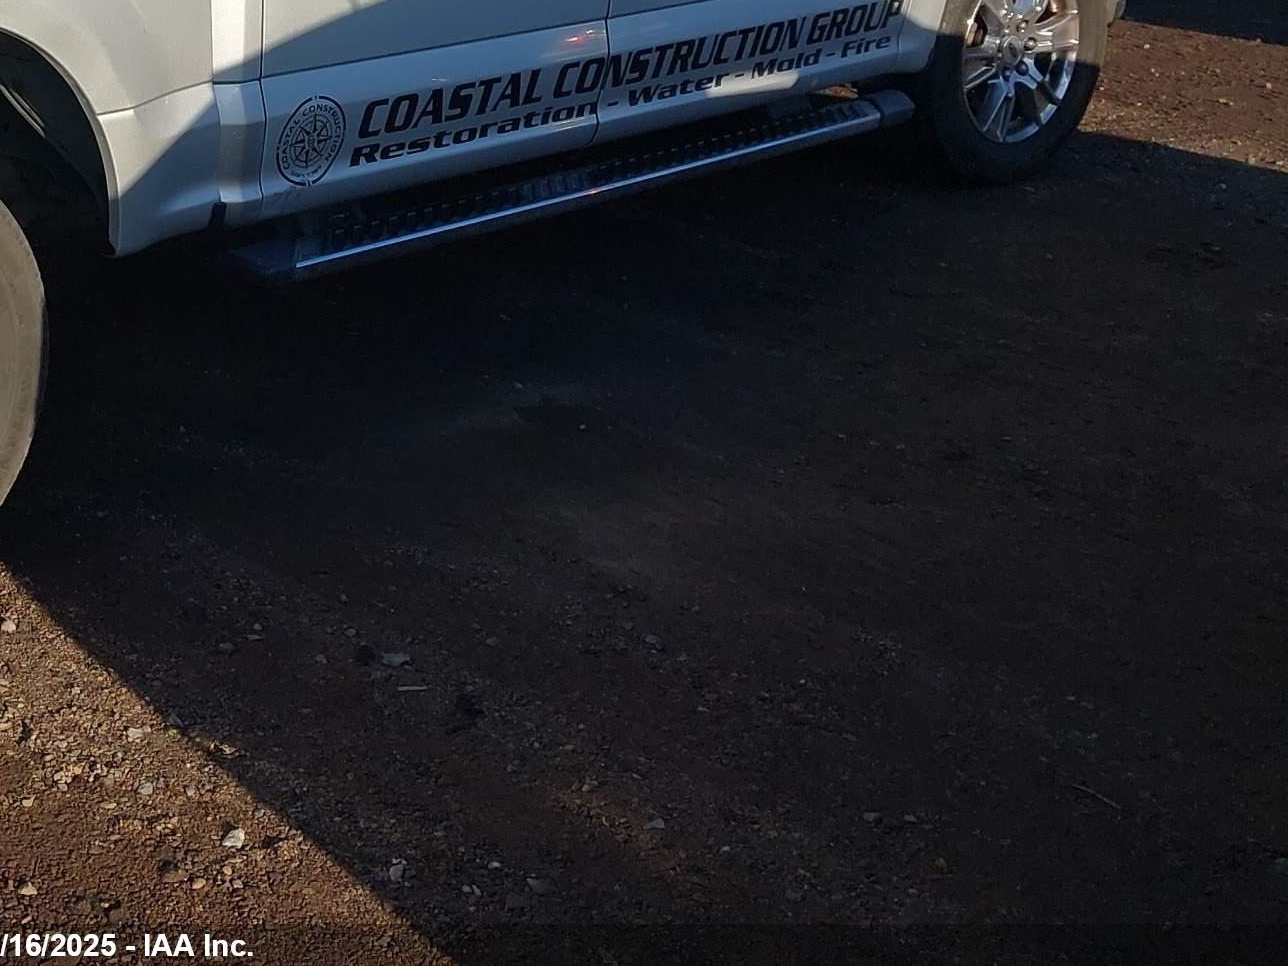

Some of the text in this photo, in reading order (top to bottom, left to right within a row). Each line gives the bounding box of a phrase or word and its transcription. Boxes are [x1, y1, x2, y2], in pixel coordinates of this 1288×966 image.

[281, 103, 342, 171] COASTAL CONSTRUCTION
[349, 101, 598, 167] Restoration
[628, 73, 730, 106] Water
[752, 47, 822, 80] Mold
[841, 35, 893, 59] Fire
[358, 68, 543, 139] COASTAL
[553, 16, 807, 98] CONSTRUCTION
